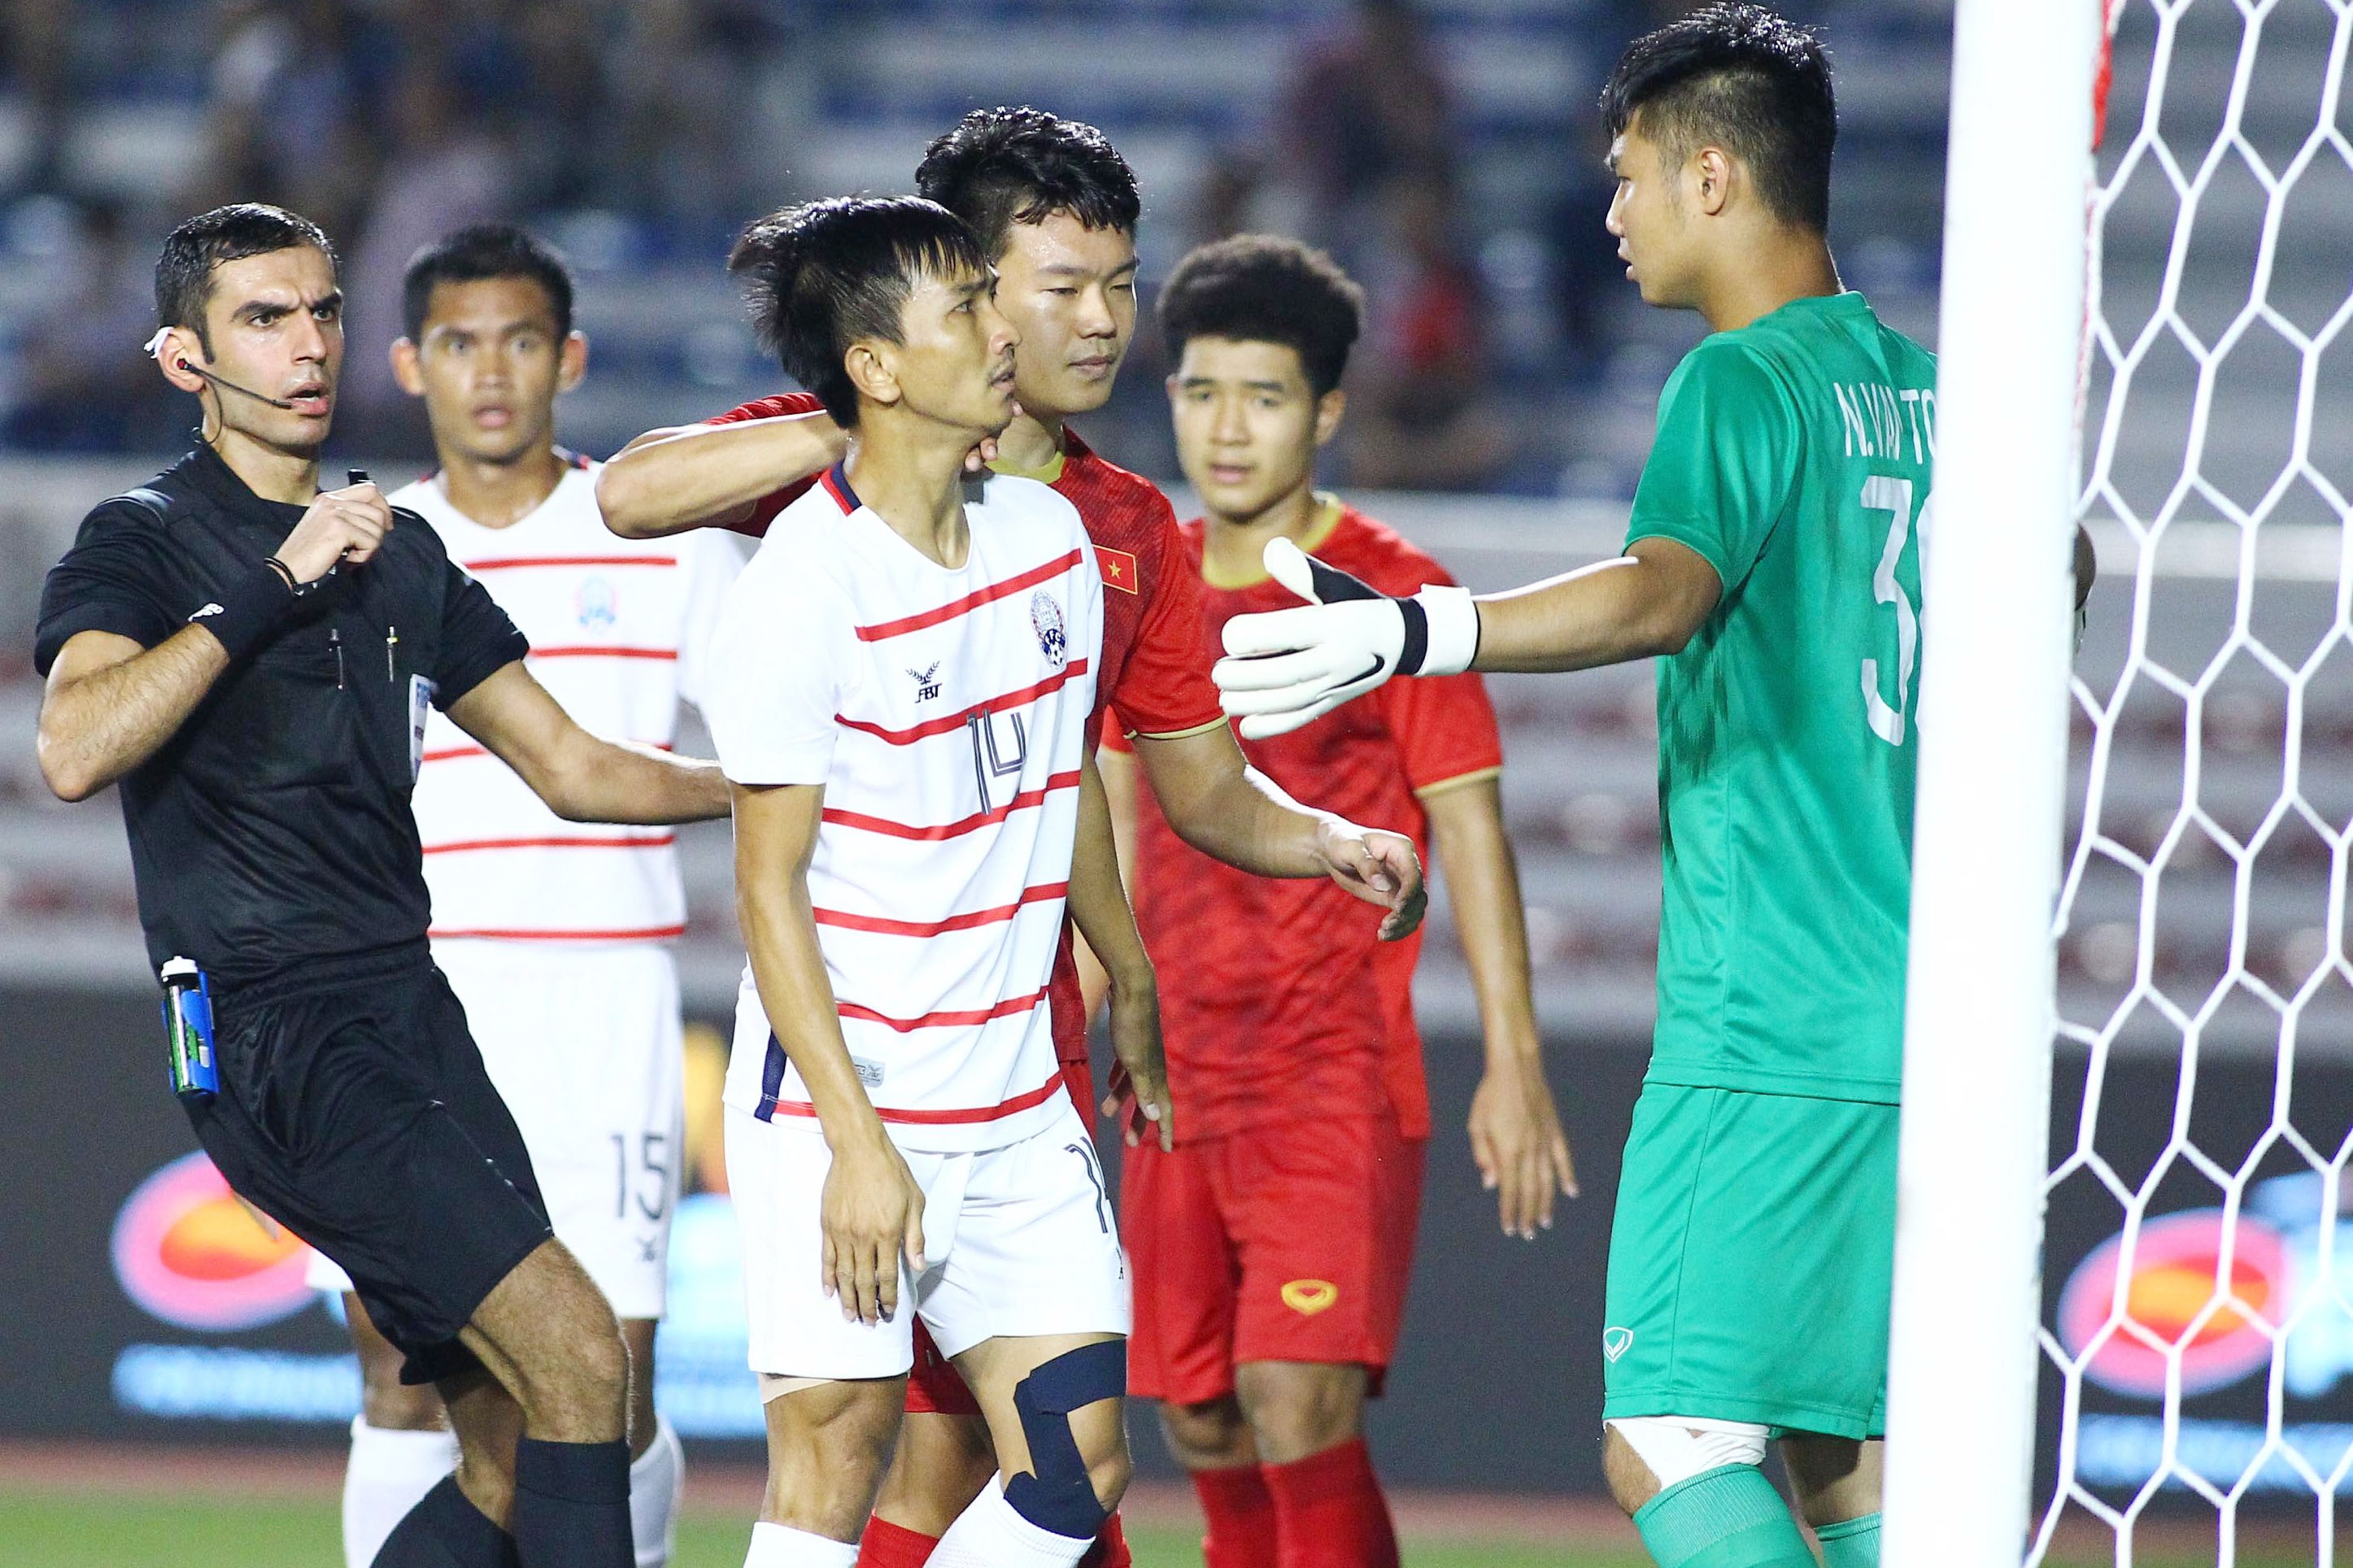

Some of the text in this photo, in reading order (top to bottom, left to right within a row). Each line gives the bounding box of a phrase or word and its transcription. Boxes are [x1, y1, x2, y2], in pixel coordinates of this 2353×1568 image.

[1860, 475, 1928, 747] 3
[915, 683, 943, 703] FBT
[967, 708, 1026, 815] 14
[610, 1133, 668, 1220] 15
